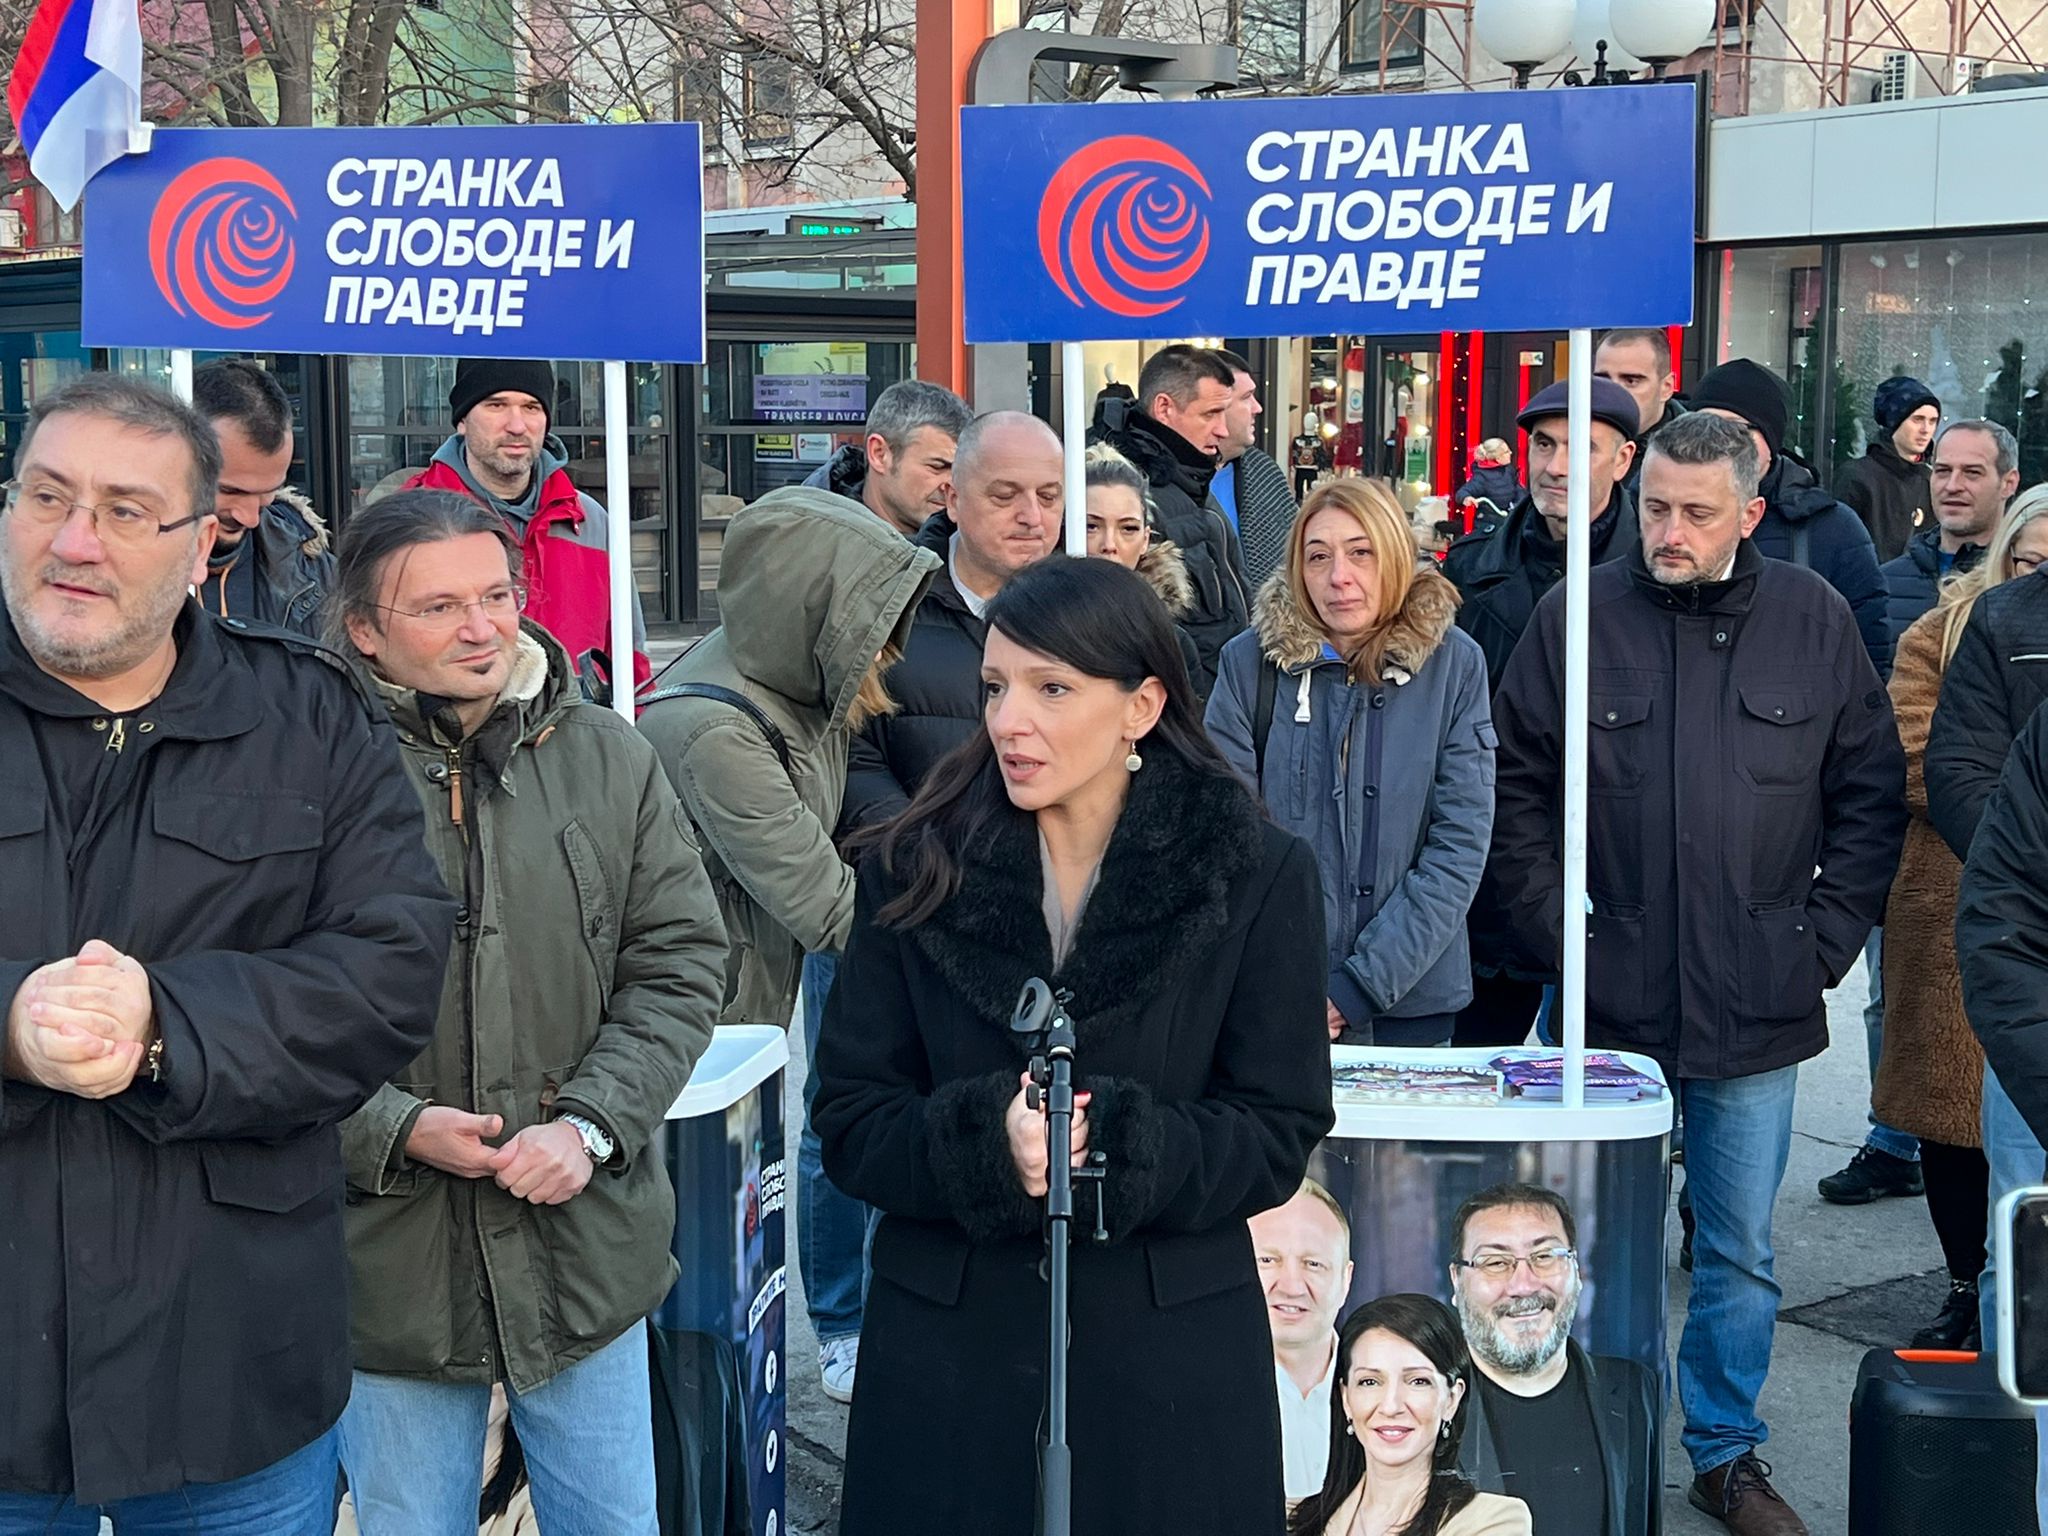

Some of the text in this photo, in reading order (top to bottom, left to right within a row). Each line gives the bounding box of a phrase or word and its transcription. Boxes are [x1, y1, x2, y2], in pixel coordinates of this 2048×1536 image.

[326, 157, 565, 208] СТРАНКА
[1246, 122, 1530, 183] СТРАНКА
[1246, 181, 1614, 246] СЛОБОДЕ И
[325, 217, 635, 277] СЛОБОДЕ И
[324, 276, 528, 336] ПРАВДЕ
[1245, 248, 1486, 310] ПРАВДЕ
[764, 411, 822, 423] TRANSFER
